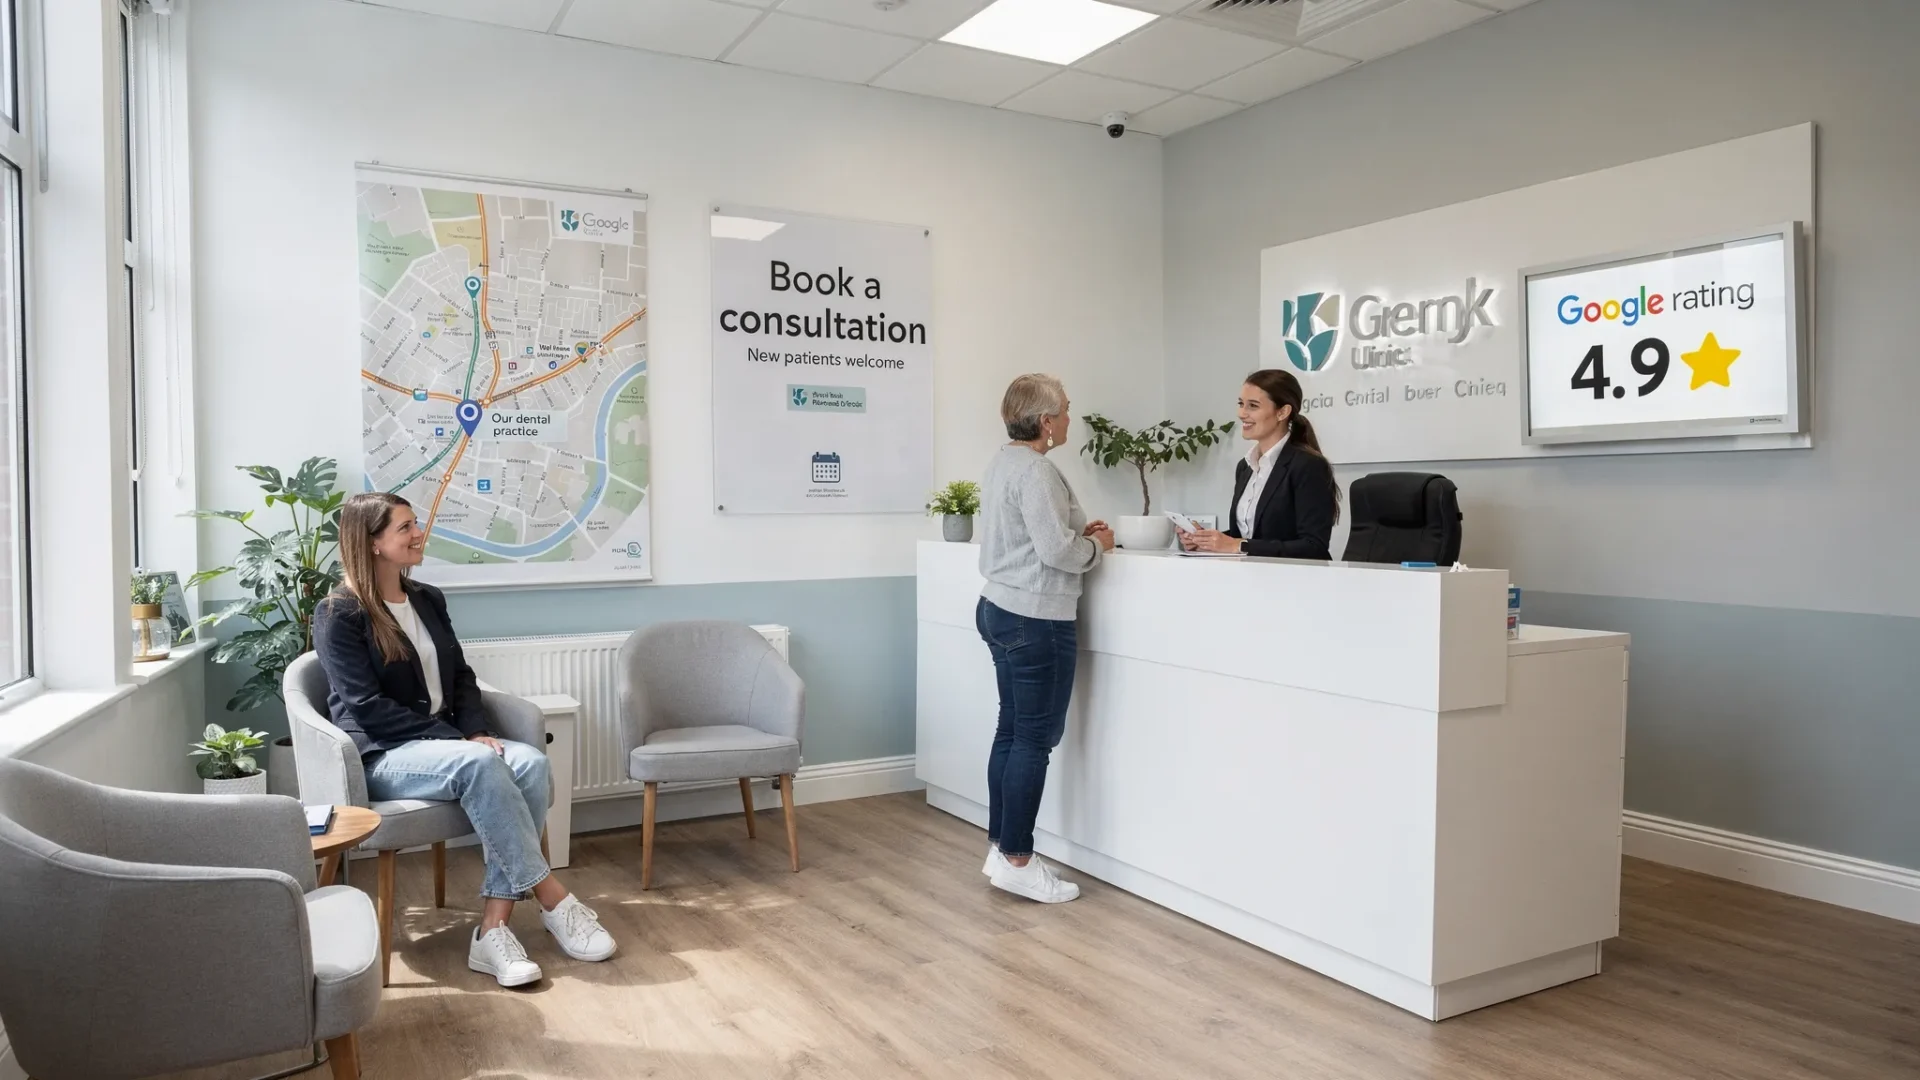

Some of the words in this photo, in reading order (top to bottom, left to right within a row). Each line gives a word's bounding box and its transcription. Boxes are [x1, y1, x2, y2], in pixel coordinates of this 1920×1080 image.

[582, 212, 629, 233] Google
[770, 260, 854, 297] Book
[864, 277, 881, 299] a
[1557, 285, 1664, 326] Google
[1673, 281, 1755, 310] rating
[720, 308, 926, 344] consultation
[747, 348, 780, 363] New
[784, 351, 841, 366] patients
[845, 354, 905, 369] welcome
[1571, 337, 1670, 400] 4.9
[492, 413, 513, 423] Our
[516, 414, 551, 424] dental
[493, 427, 538, 437] practice
